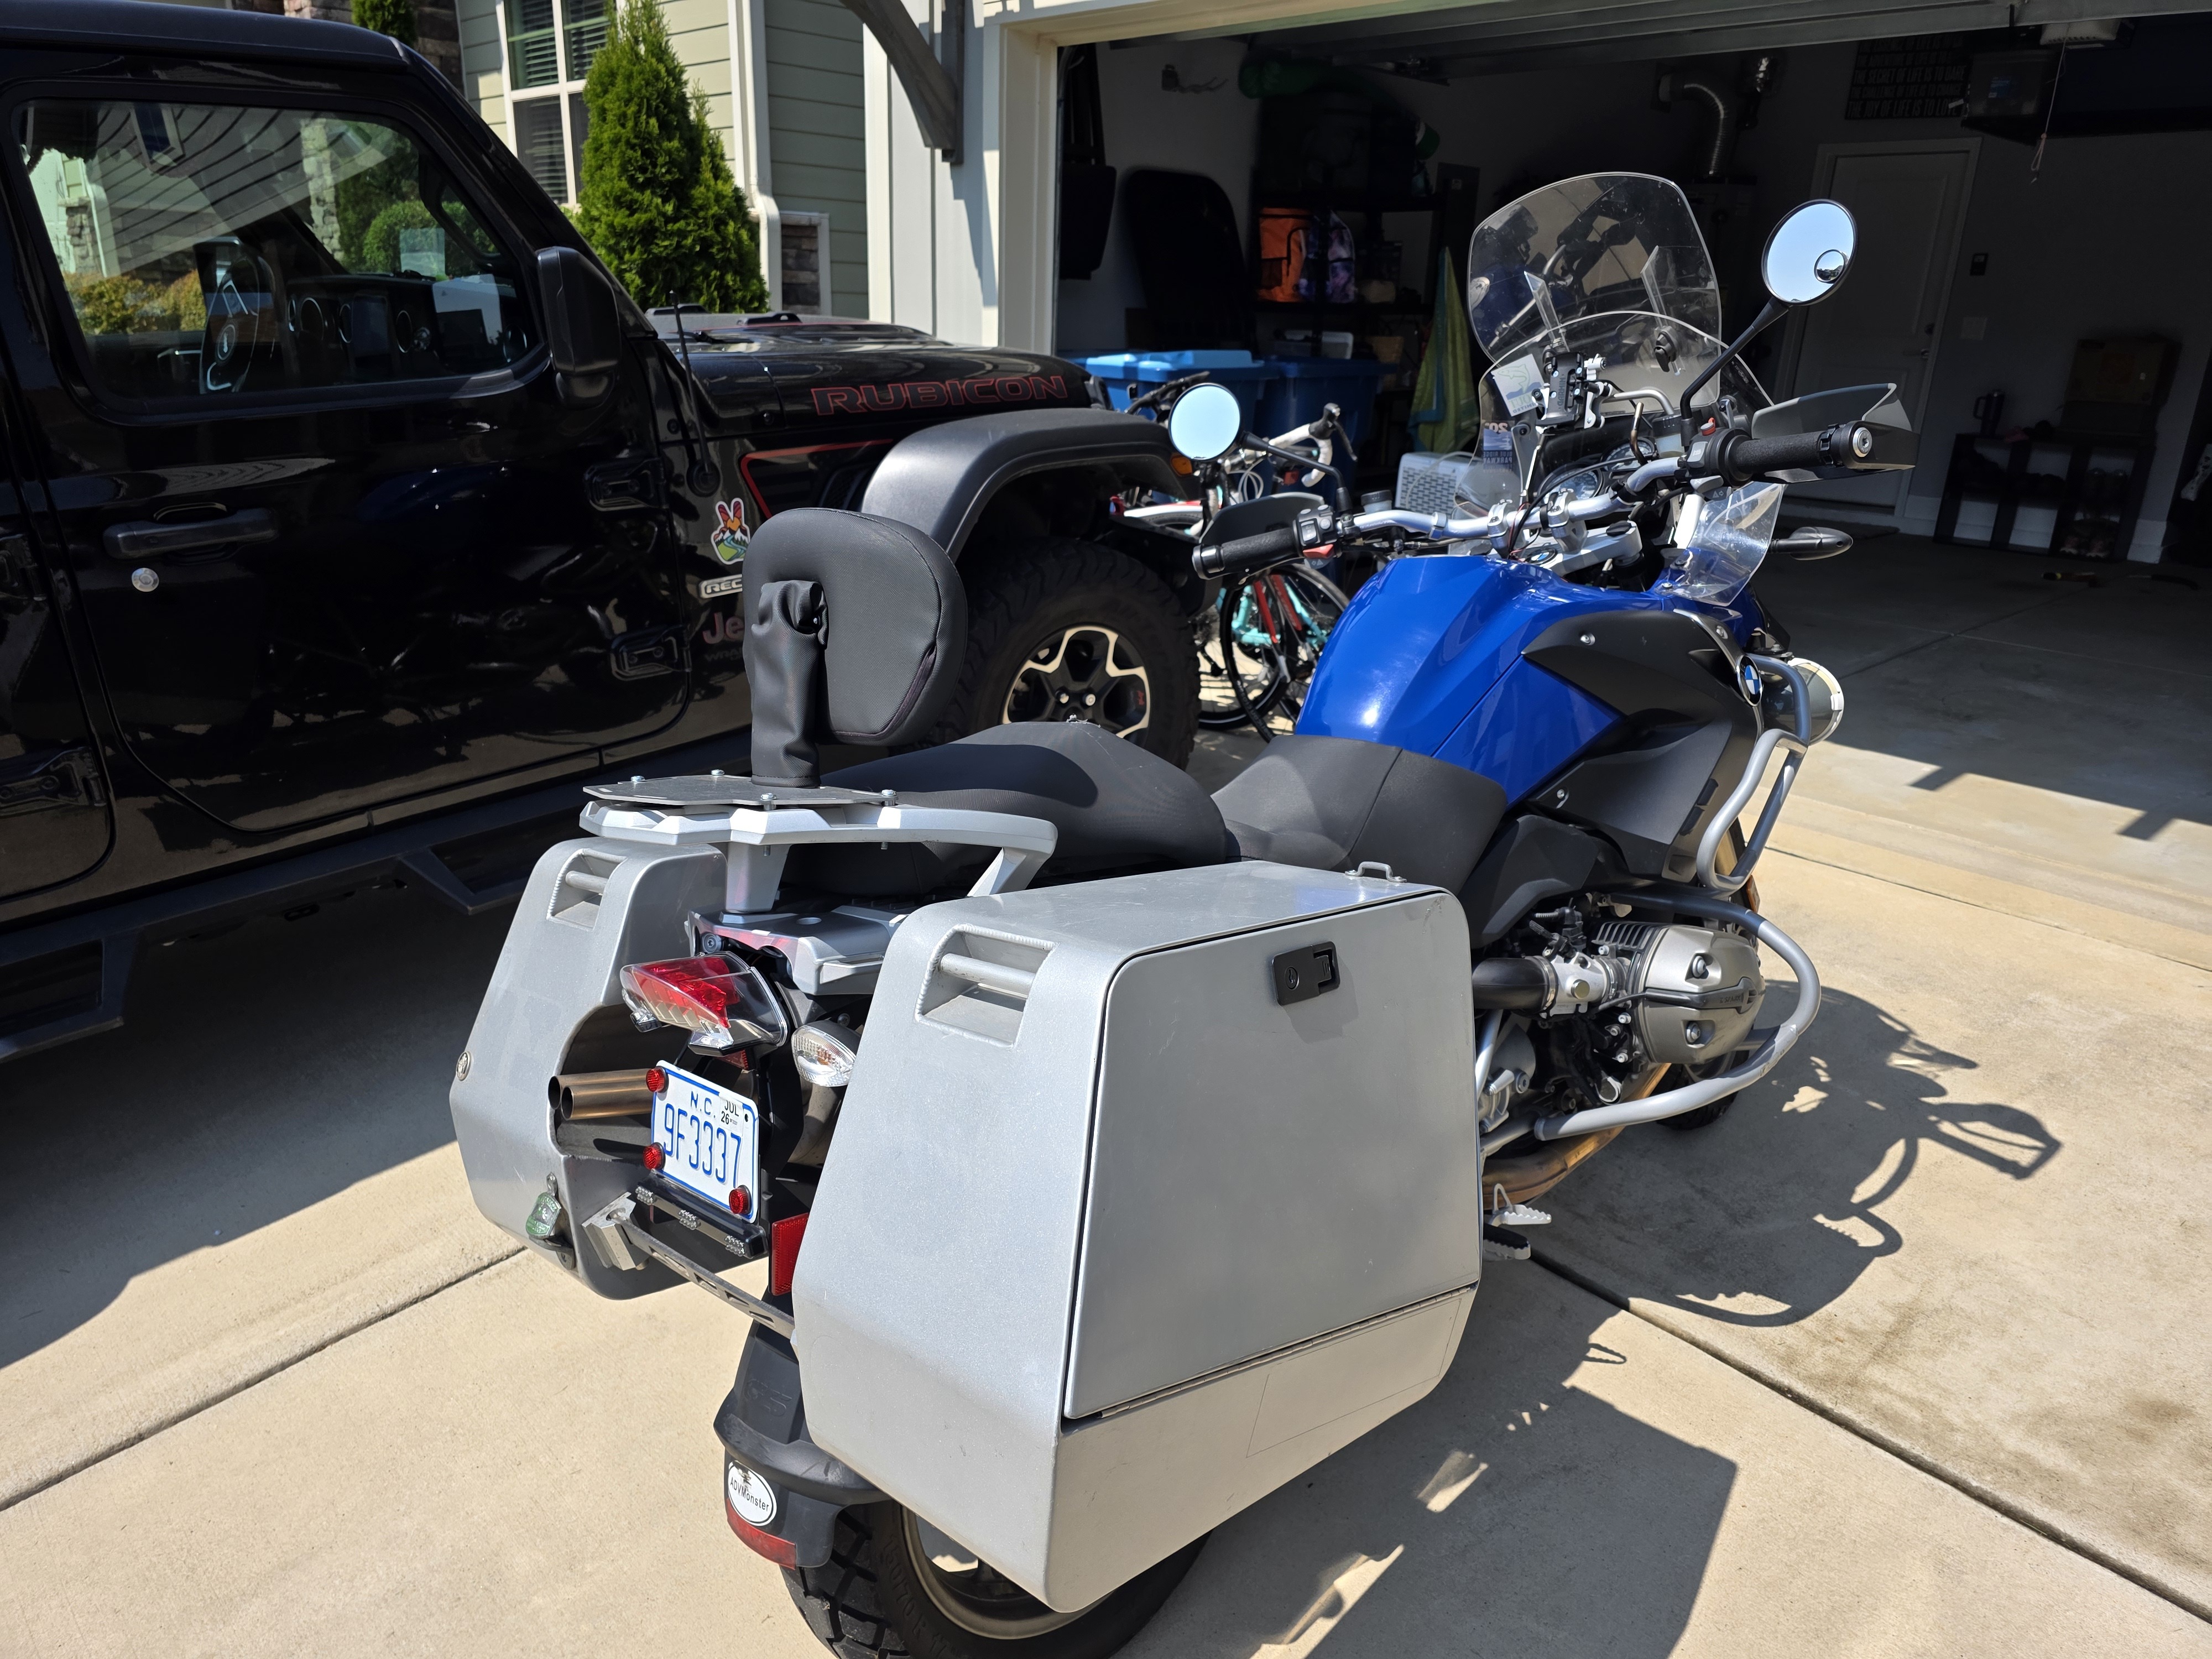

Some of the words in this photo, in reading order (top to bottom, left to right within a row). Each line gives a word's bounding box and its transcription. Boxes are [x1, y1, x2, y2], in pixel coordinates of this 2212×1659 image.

[1854, 70, 1867, 84] THE
[1867, 69, 1896, 84] SECRET
[1896, 68, 1907, 82] OF
[1907, 67, 1924, 82] LIFE
[1924, 67, 1933, 81] IS
[1934, 66, 1944, 81] TO
[1848, 101, 1863, 117] THE
[1864, 101, 1881, 117] JOY
[1881, 100, 1892, 117] OF
[1893, 100, 1912, 116] LIFE
[1912, 99, 1922, 116] IS
[1924, 99, 1935, 115] TO
[811, 375, 1068, 416] RUBICON
[1557, 377, 1566, 406] GARMIN
[721, 1110, 730, 1125] 26
[724, 1100, 739, 1117] JUL
[663, 1103, 741, 1188] 9F3337
[730, 1477, 770, 1512] ADVMonster
